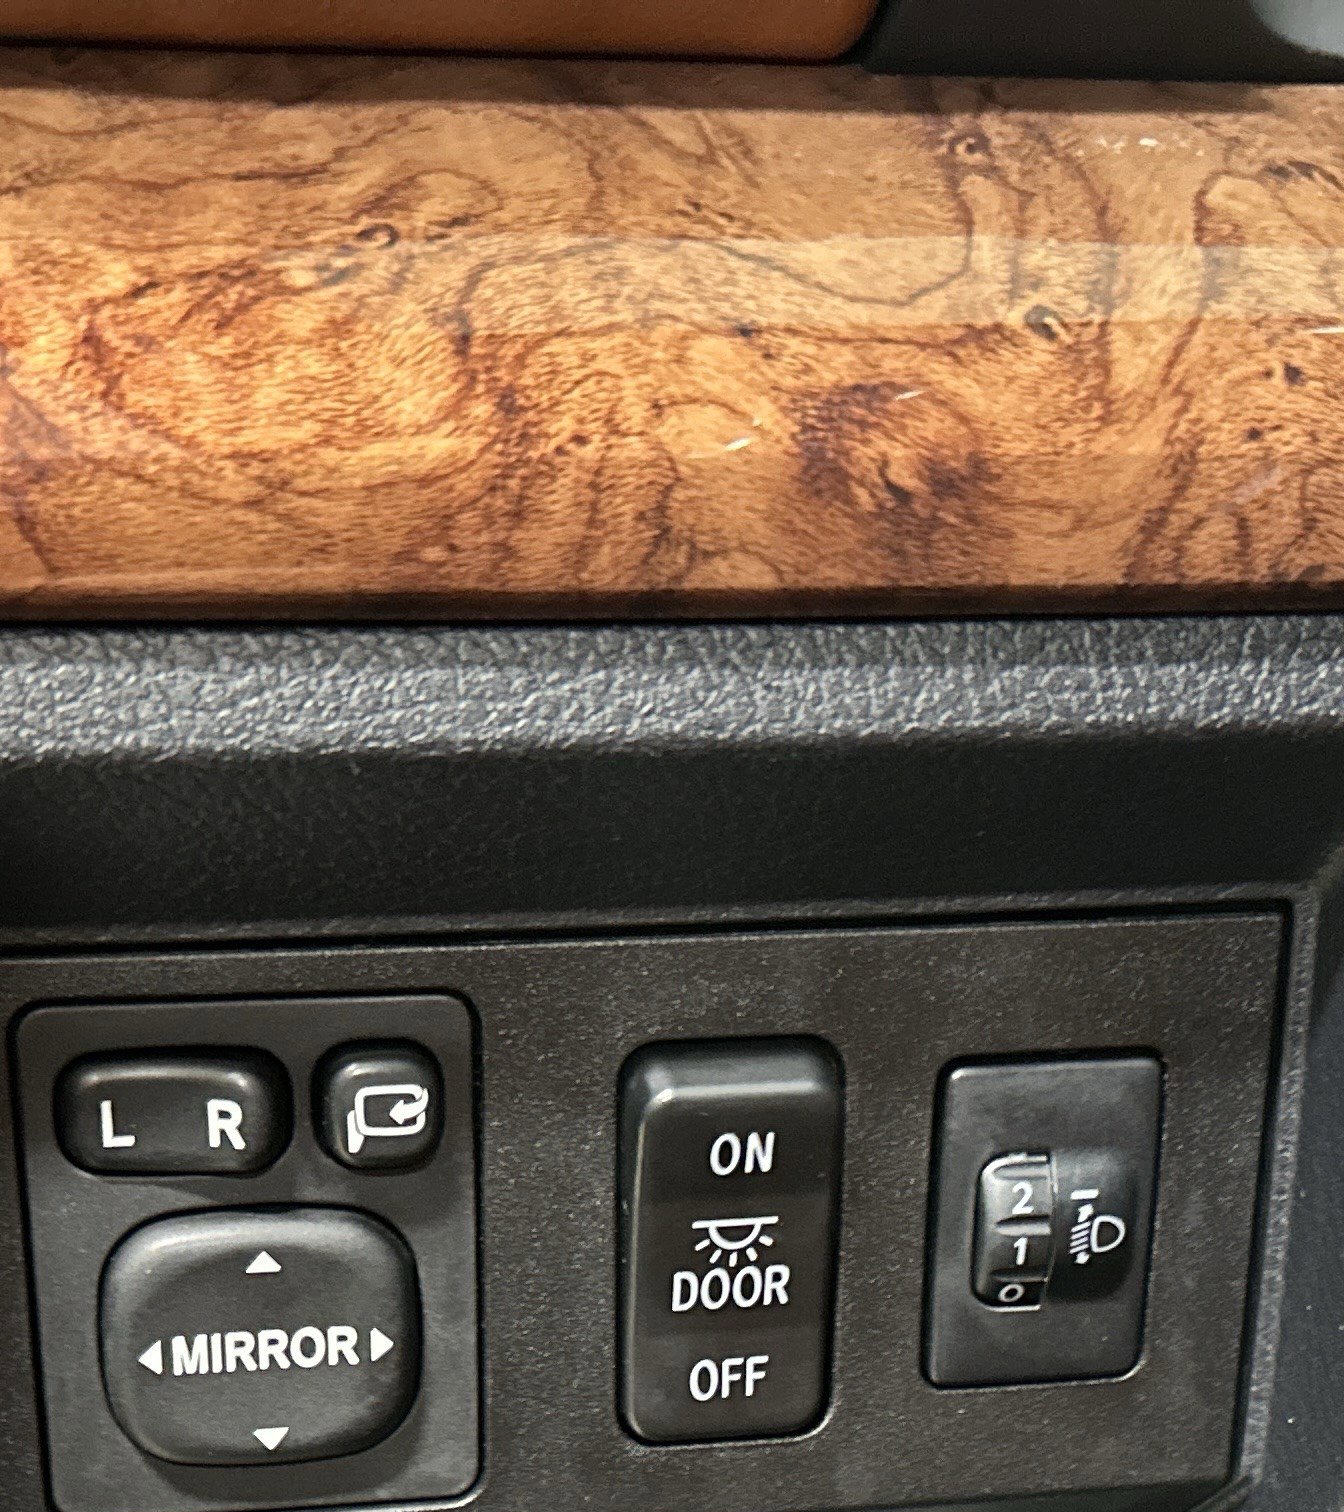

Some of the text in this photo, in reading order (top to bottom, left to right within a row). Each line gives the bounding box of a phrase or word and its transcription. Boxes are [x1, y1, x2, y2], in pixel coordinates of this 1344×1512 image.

[100, 1099, 247, 1150] L R
[709, 1132, 776, 1176] ON
[1011, 1181, 1035, 1215] 2
[1013, 1236, 1029, 1266] 1
[671, 1264, 790, 1312] DOOR
[997, 1283, 1025, 1303] 0
[171, 1324, 360, 1376] MIRROR
[689, 1355, 770, 1402] OFF
